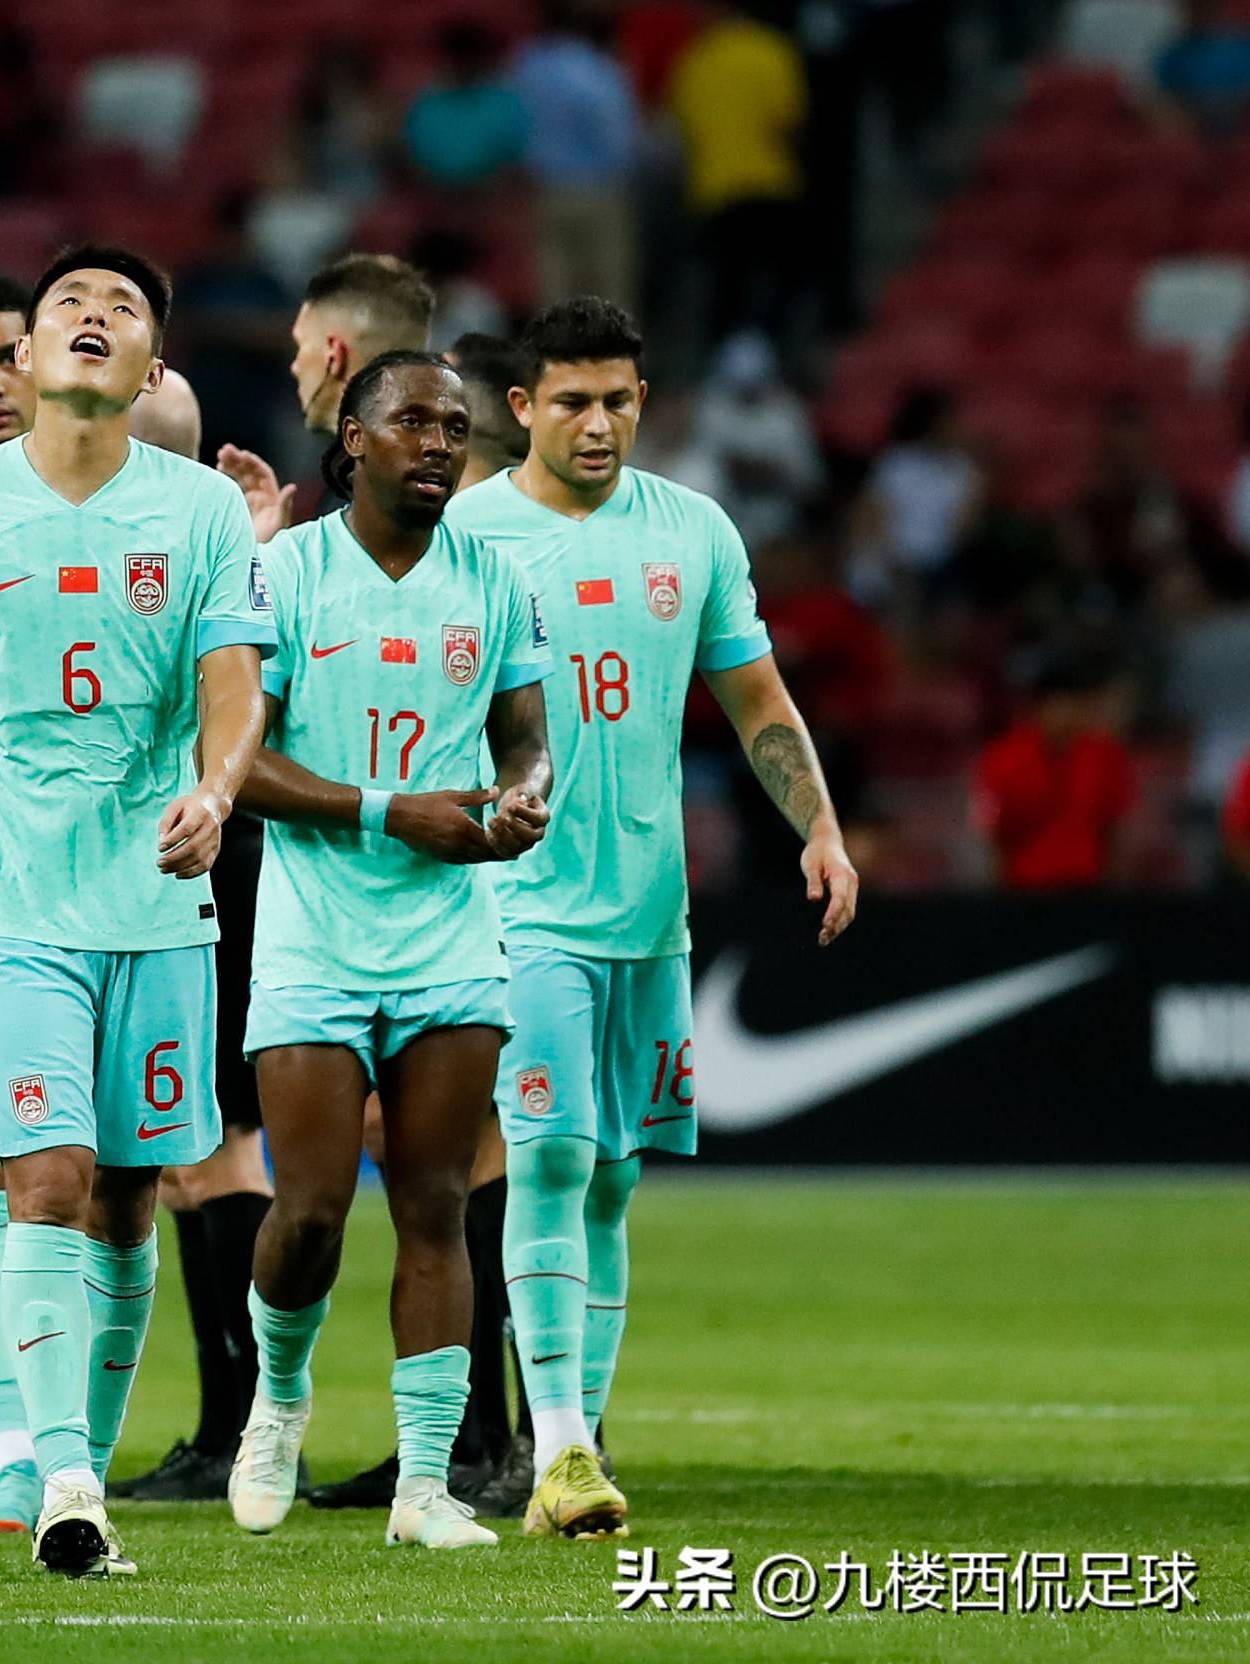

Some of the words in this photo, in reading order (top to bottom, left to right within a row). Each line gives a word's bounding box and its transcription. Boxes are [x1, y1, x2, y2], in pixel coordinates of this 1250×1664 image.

[129, 558, 163, 570] CFA
[63, 642, 102, 714] 6
[569, 650, 630, 723] 18
[366, 707, 425, 781] 17
[13, 1079, 41, 1093] CFA
[145, 1040, 183, 1112] 6
[651, 1038, 694, 1107] 18
